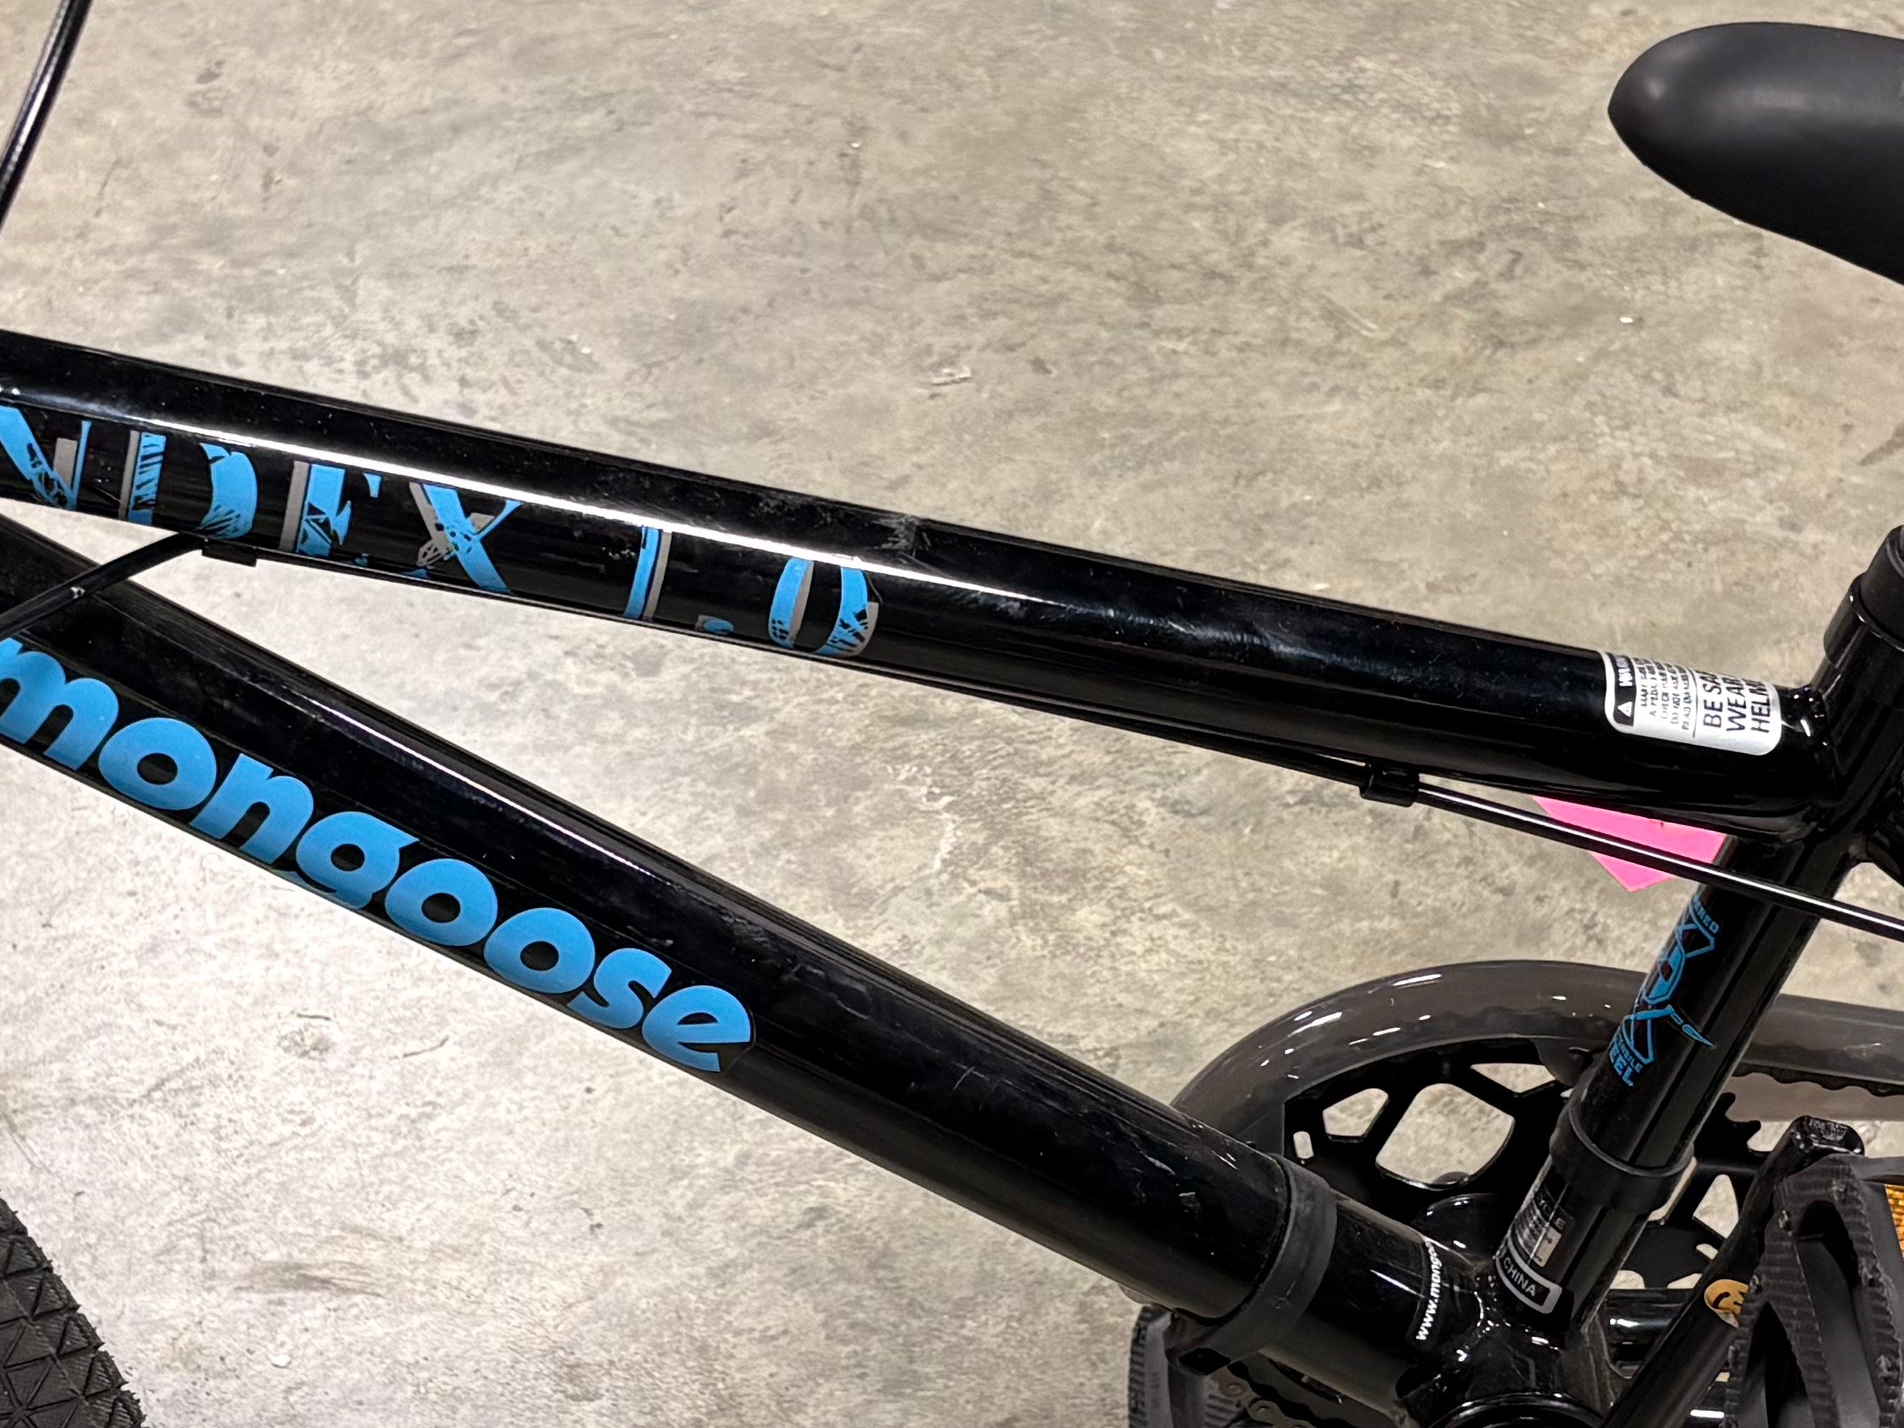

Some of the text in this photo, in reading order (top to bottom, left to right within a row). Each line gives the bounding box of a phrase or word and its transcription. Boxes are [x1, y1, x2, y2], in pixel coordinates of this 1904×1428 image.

[622, 525, 879, 658] 1.0
[1699, 672, 1724, 729] BE SA
[1502, 1256, 1537, 1297] CHINA
